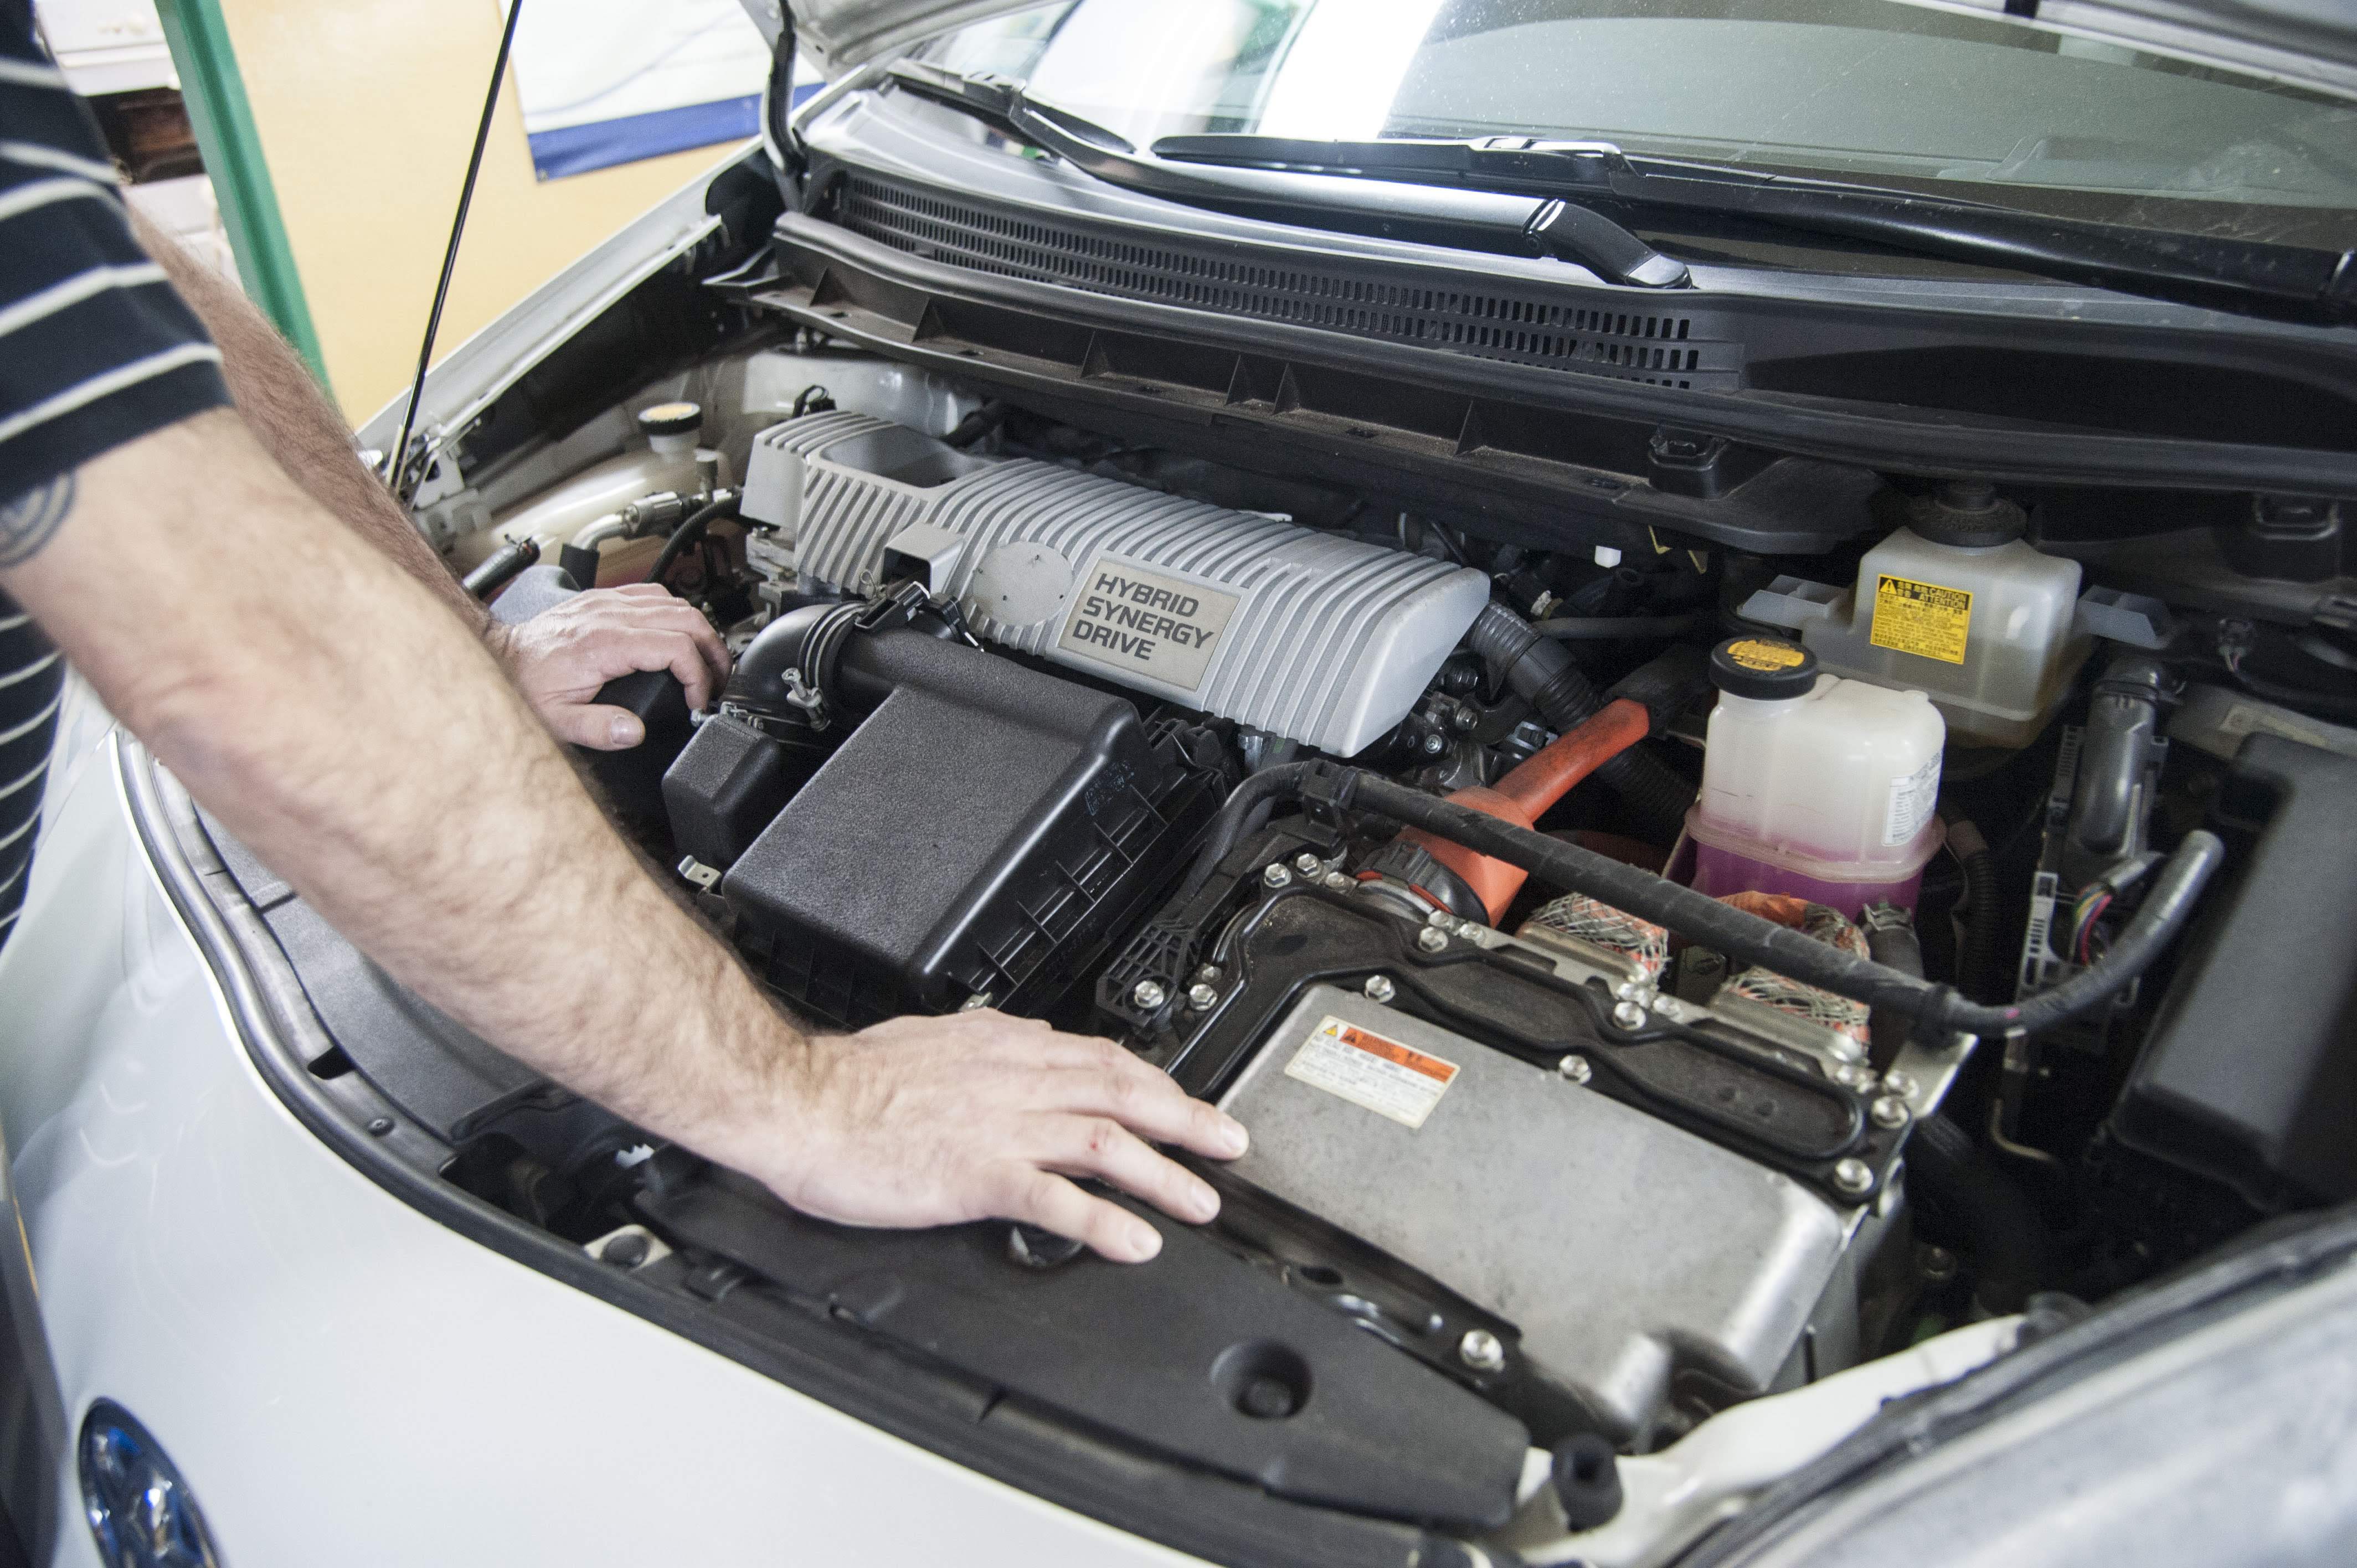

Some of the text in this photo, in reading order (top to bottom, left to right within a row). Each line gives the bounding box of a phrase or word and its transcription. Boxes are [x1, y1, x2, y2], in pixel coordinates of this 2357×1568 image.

[1094, 573, 1199, 618] HYBRID
[1918, 594, 1966, 609] ATTENTION
[1929, 587, 1967, 602] CAUTION
[1072, 619, 1156, 661] DRIVE
[1083, 596, 1214, 649] SYNERGY
